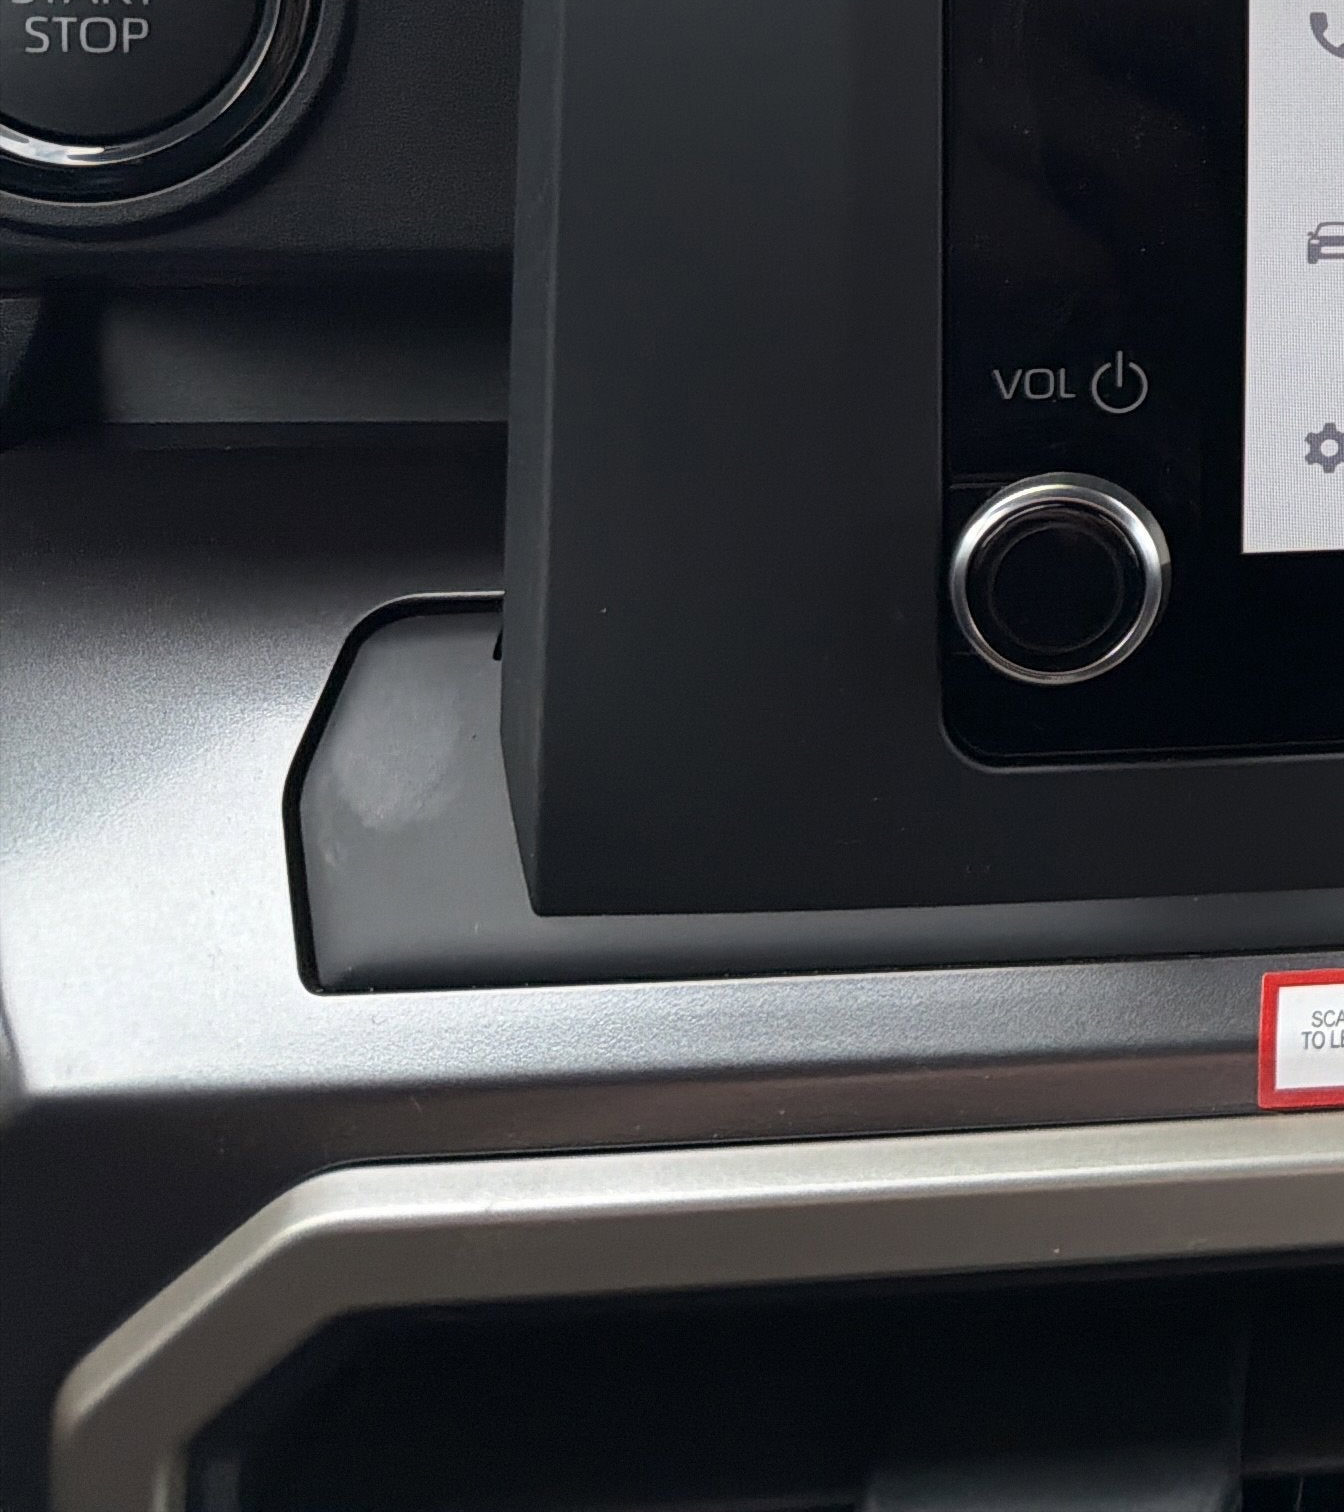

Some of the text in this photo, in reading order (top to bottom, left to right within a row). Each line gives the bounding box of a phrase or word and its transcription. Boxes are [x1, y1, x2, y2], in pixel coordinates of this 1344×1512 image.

[24, 16, 150, 54] STOP
[991, 368, 1076, 400] VOL
[1301, 1031, 1325, 1050] TO
